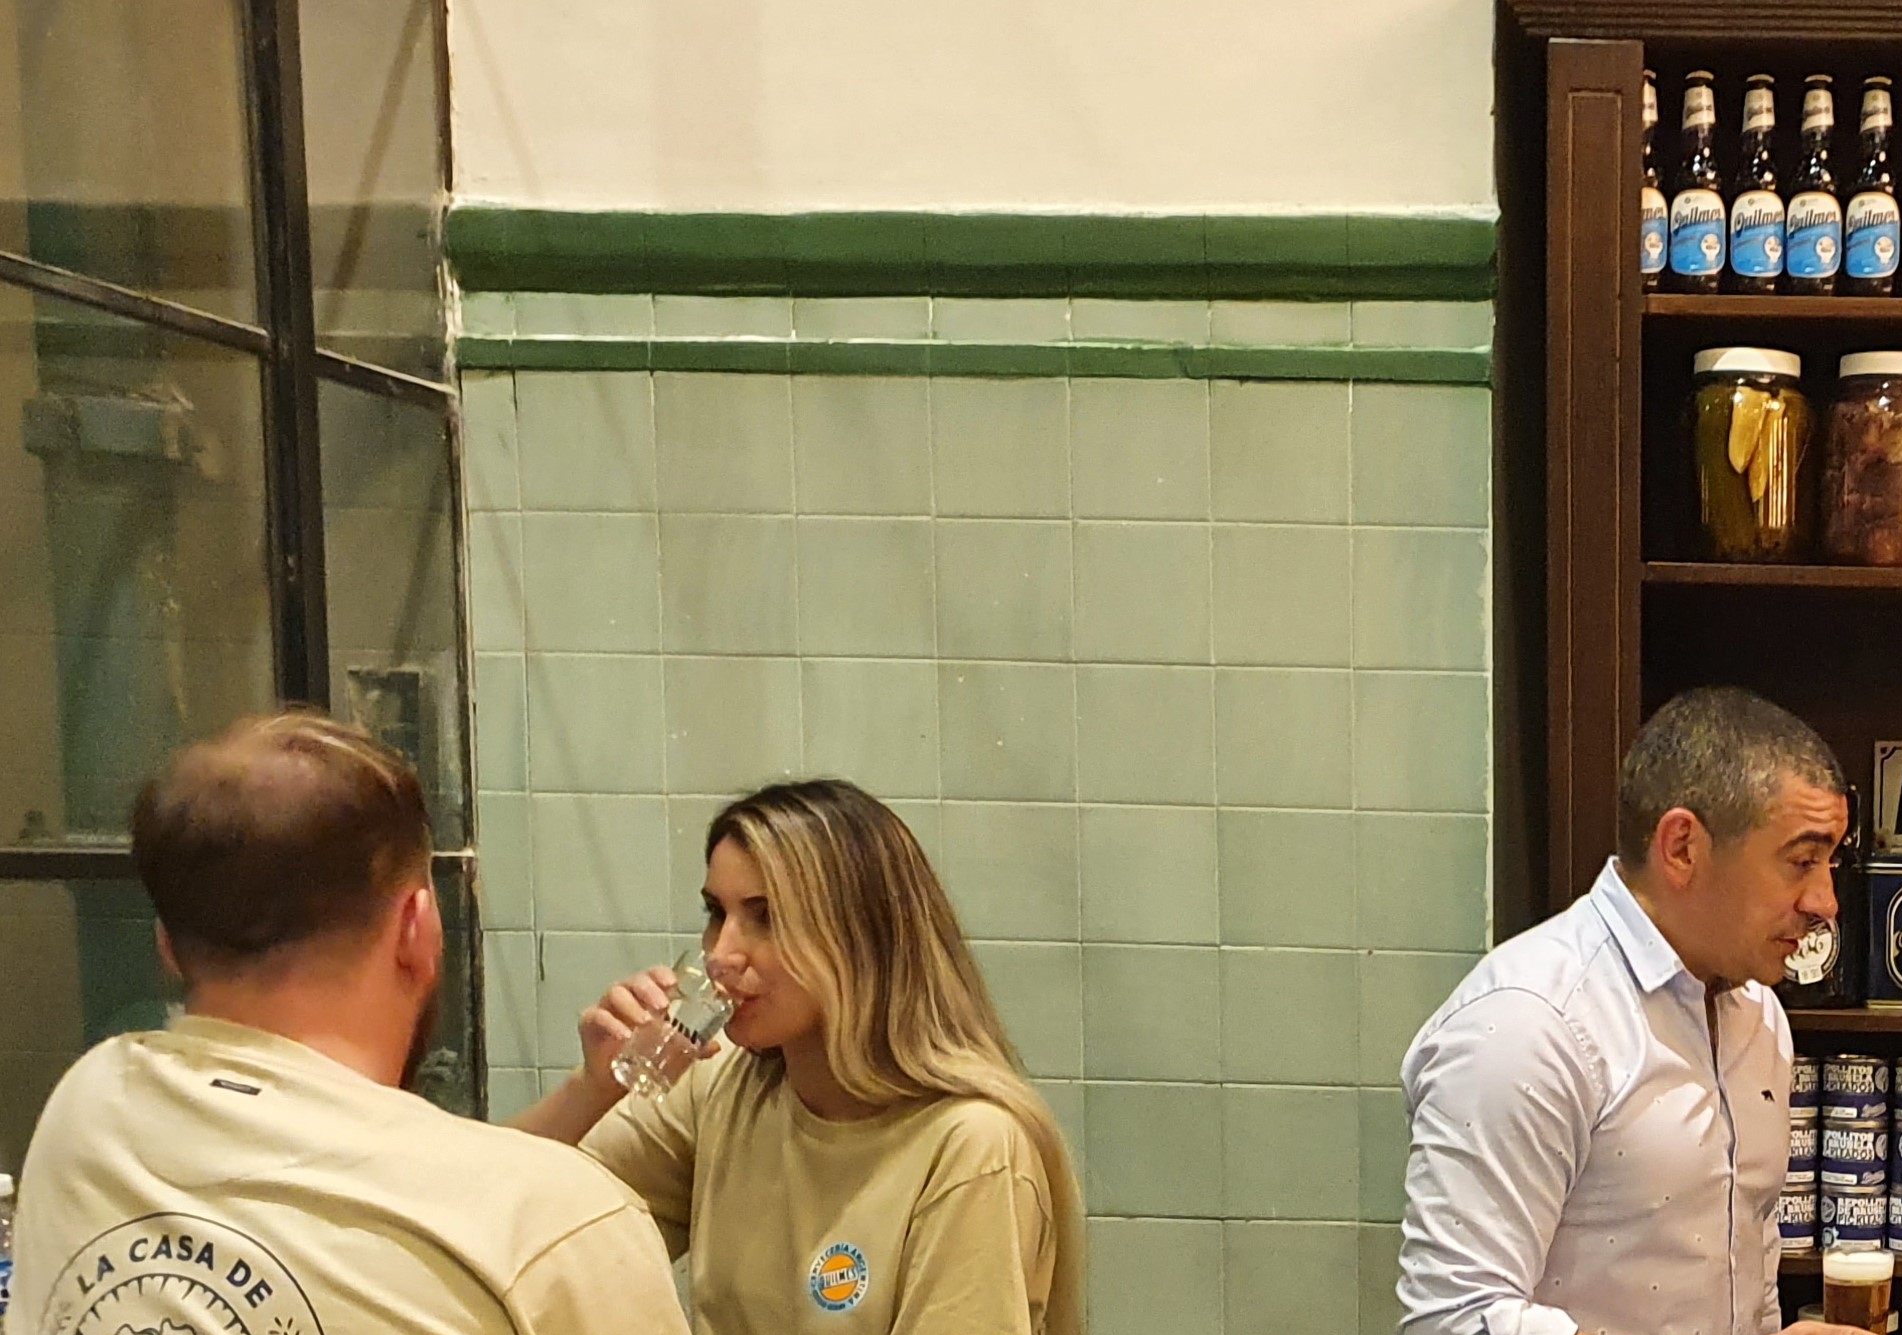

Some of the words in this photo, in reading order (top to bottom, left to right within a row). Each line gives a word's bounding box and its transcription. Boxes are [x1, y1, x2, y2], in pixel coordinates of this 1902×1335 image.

[77, 1255, 115, 1295] LA
[129, 1234, 214, 1271] CASA
[226, 1258, 273, 1309] DE
